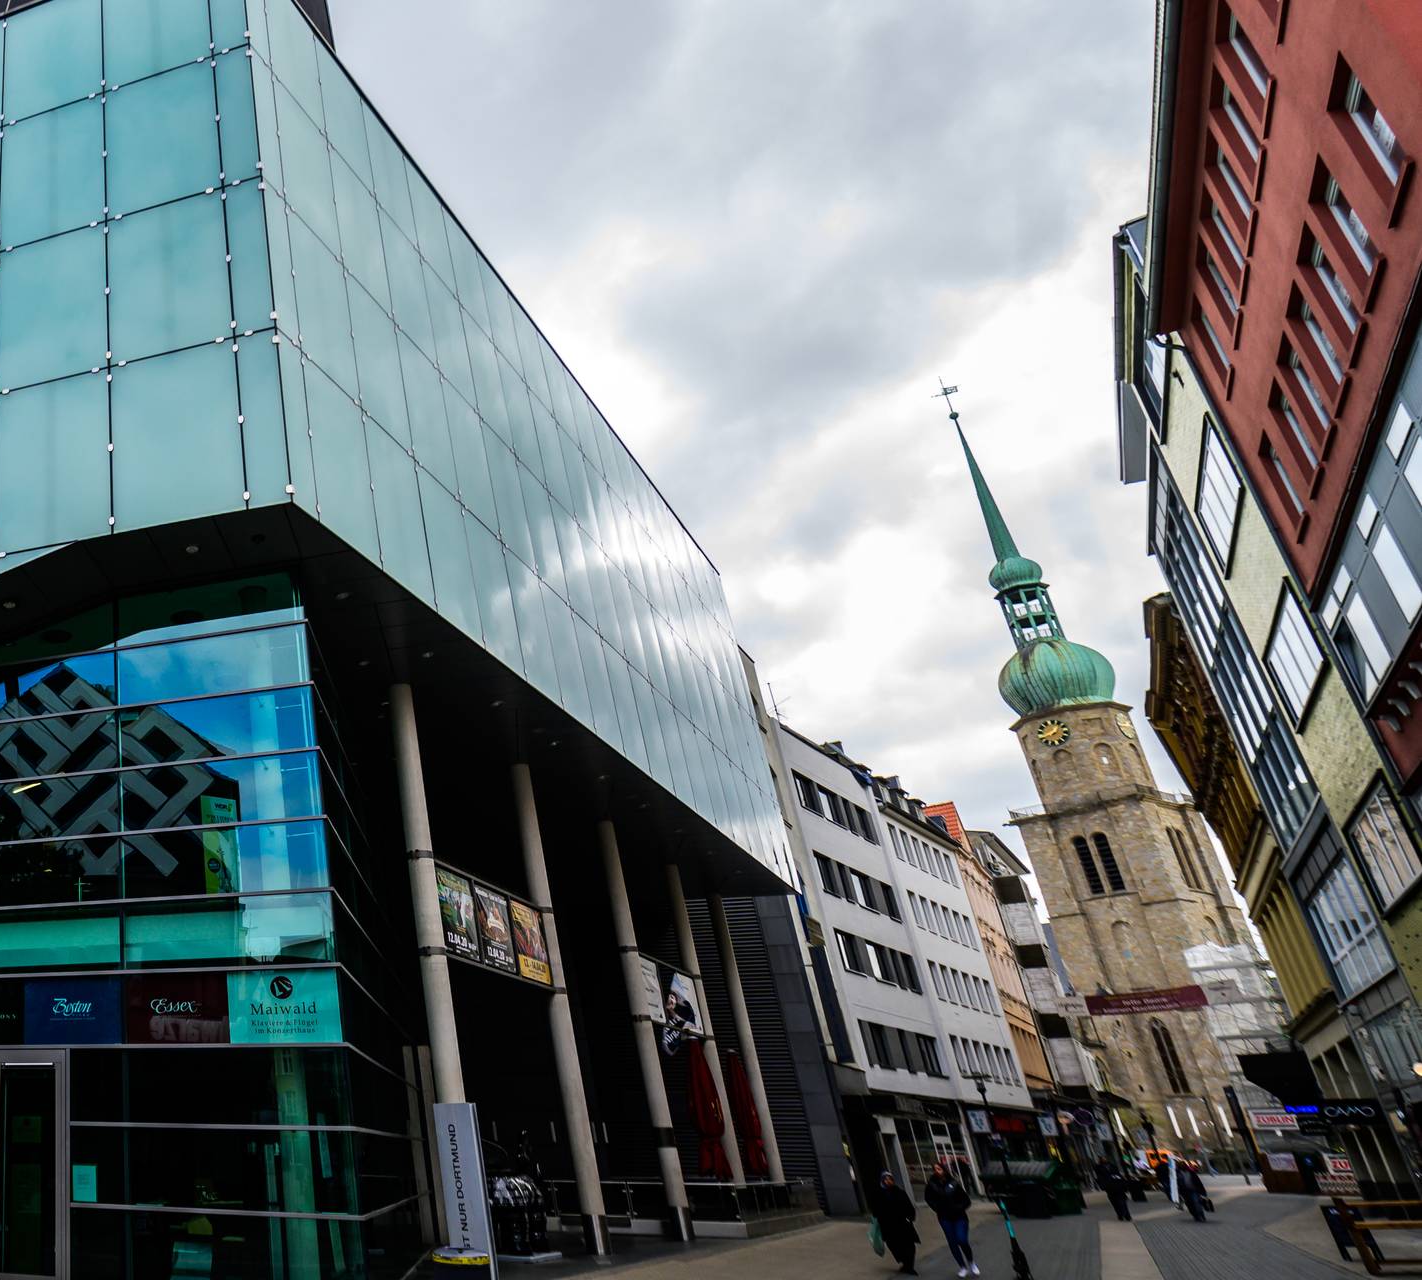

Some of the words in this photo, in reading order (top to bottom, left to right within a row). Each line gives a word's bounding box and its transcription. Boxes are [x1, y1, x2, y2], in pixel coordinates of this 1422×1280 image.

[52, 998, 92, 1017] Boston
[150, 998, 197, 1014] Essex
[250, 1002, 317, 1015] Maiwald
[447, 1123, 465, 1199] DORTMUND
[458, 1202, 469, 1231] NUR
